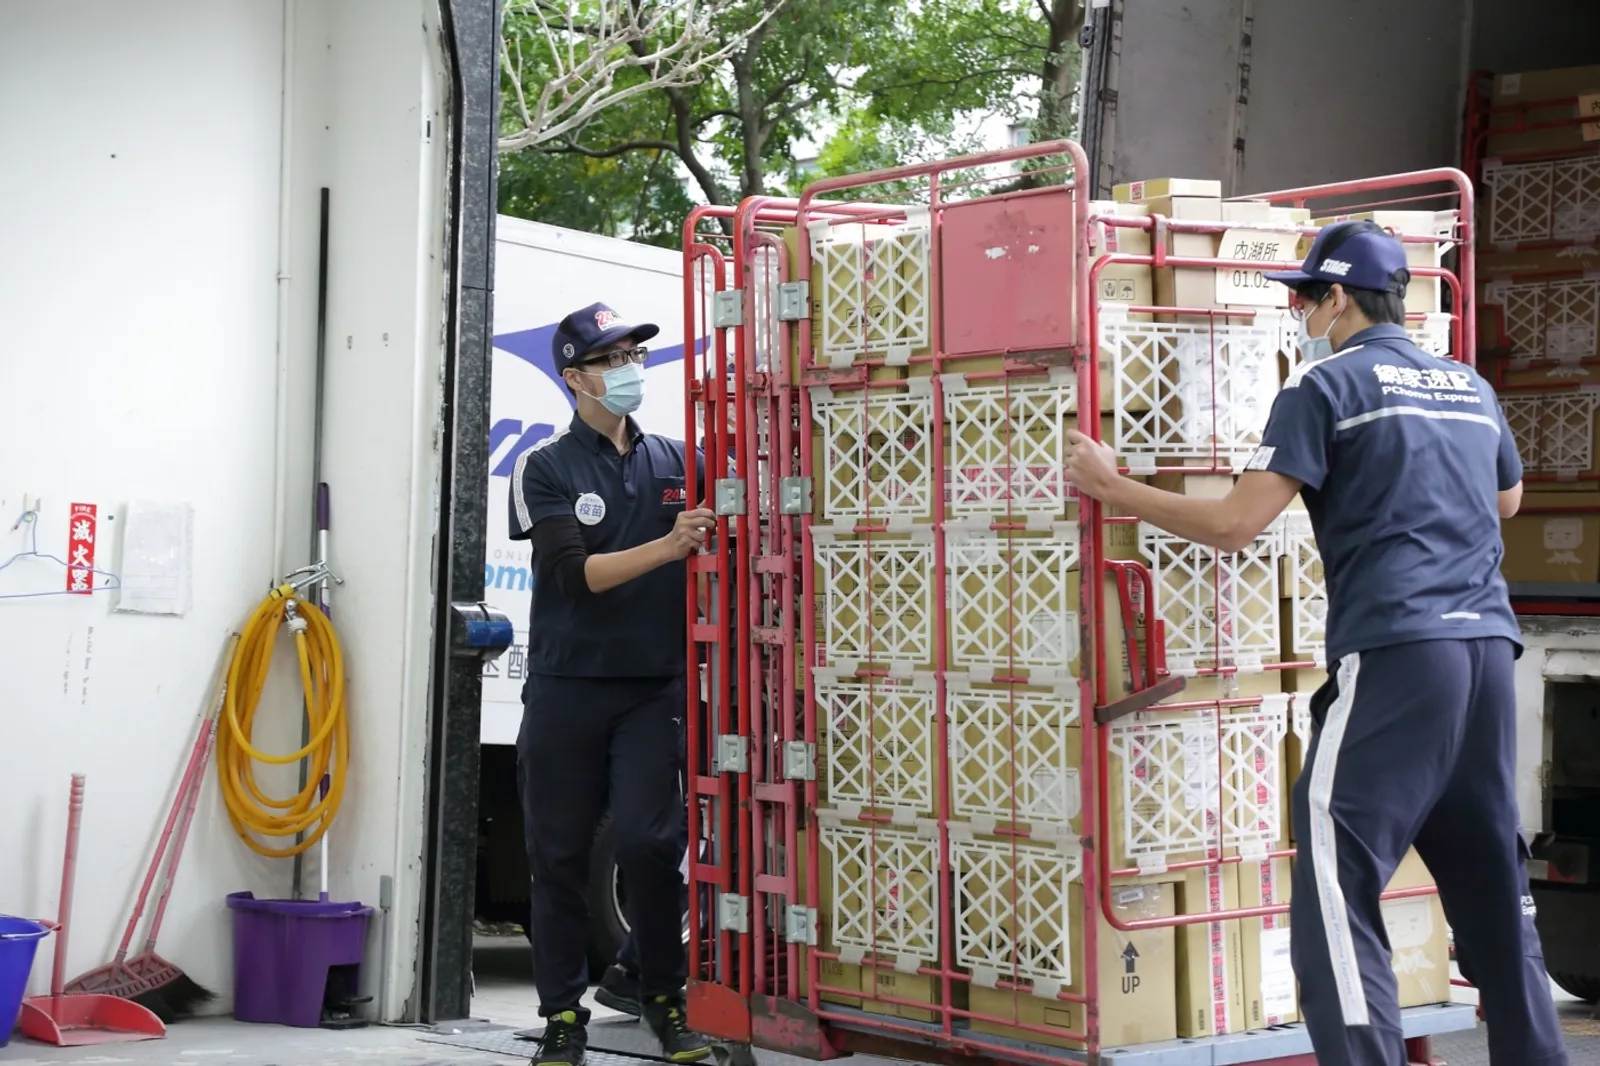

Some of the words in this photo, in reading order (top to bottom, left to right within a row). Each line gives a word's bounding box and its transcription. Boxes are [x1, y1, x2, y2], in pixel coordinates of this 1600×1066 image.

[1233, 269, 1270, 288] 01.02
[1381, 386, 1432, 400] PChome
[1433, 392, 1481, 403] Express
[579, 503, 603, 518] 疫苗
[71, 519, 93, 592] 滅火器
[1122, 975, 1140, 994] UP
